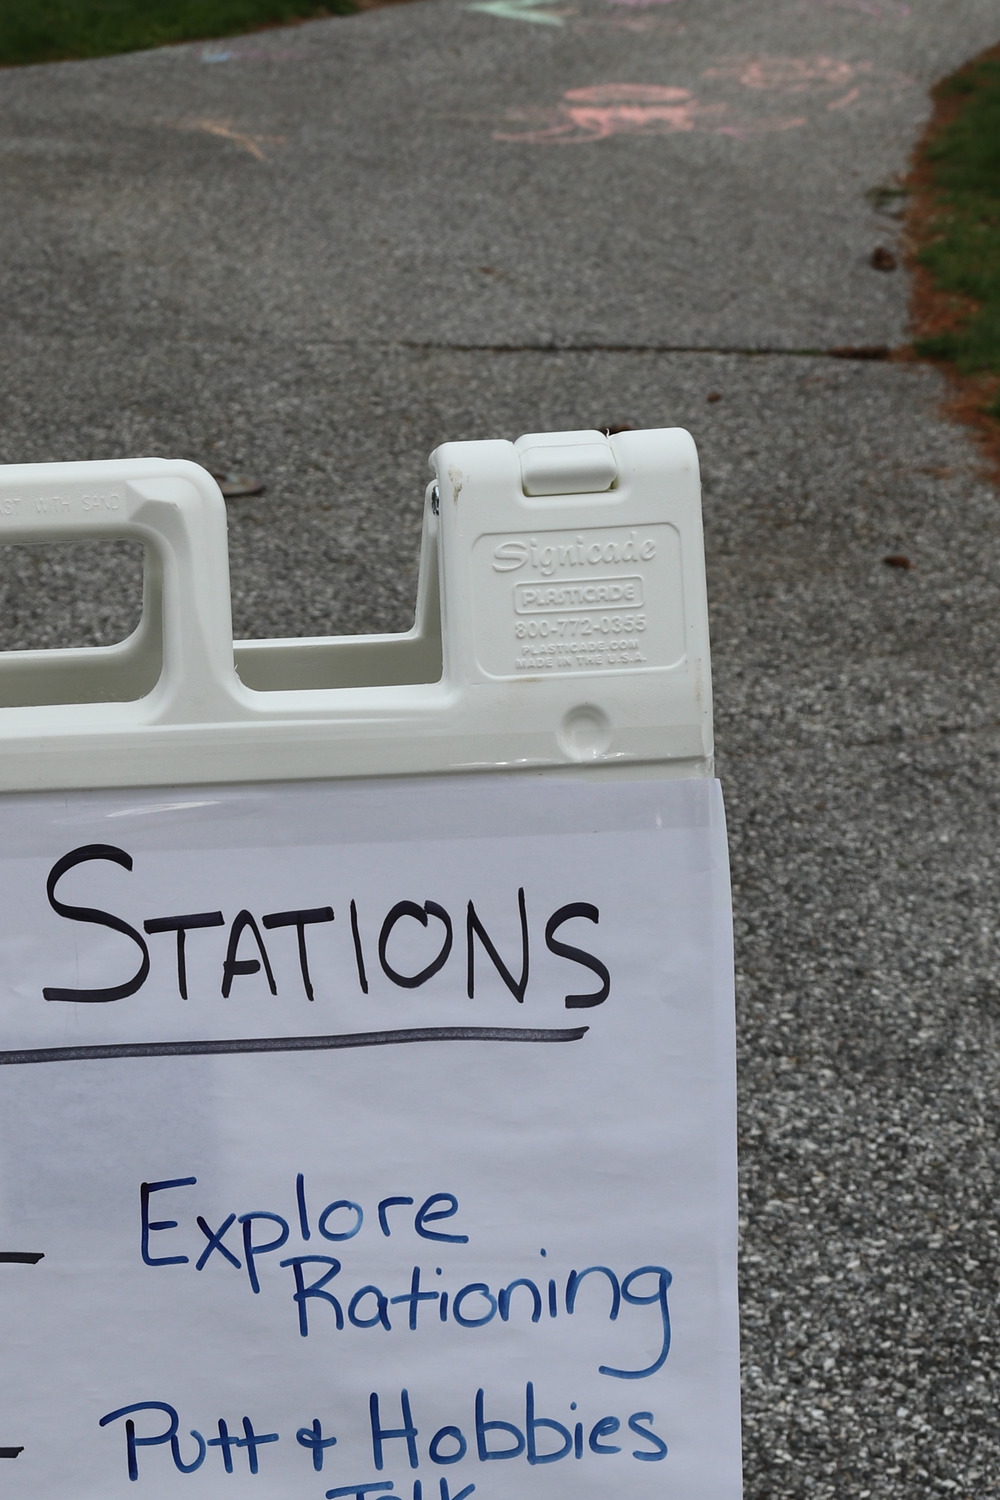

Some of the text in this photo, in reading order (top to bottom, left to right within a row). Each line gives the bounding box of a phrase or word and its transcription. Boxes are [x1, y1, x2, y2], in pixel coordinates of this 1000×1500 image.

[82, 493, 120, 511] SAND
[492, 531, 657, 576] Signicade
[522, 584, 634, 607] PLASTICADE
[515, 614, 647, 639] 800-772-0355
[516, 652, 647, 671] MADE IN THE U.S.A.
[522, 639, 639, 656] PLASTICADE.COM
[42, 844, 610, 1009] STATIONS
[140, 1173, 469, 1294] Explore
[280, 1248, 672, 1379] Rationing
[99, 1401, 279, 1481] Putt
[370, 1382, 668, 1470] Hobbies
